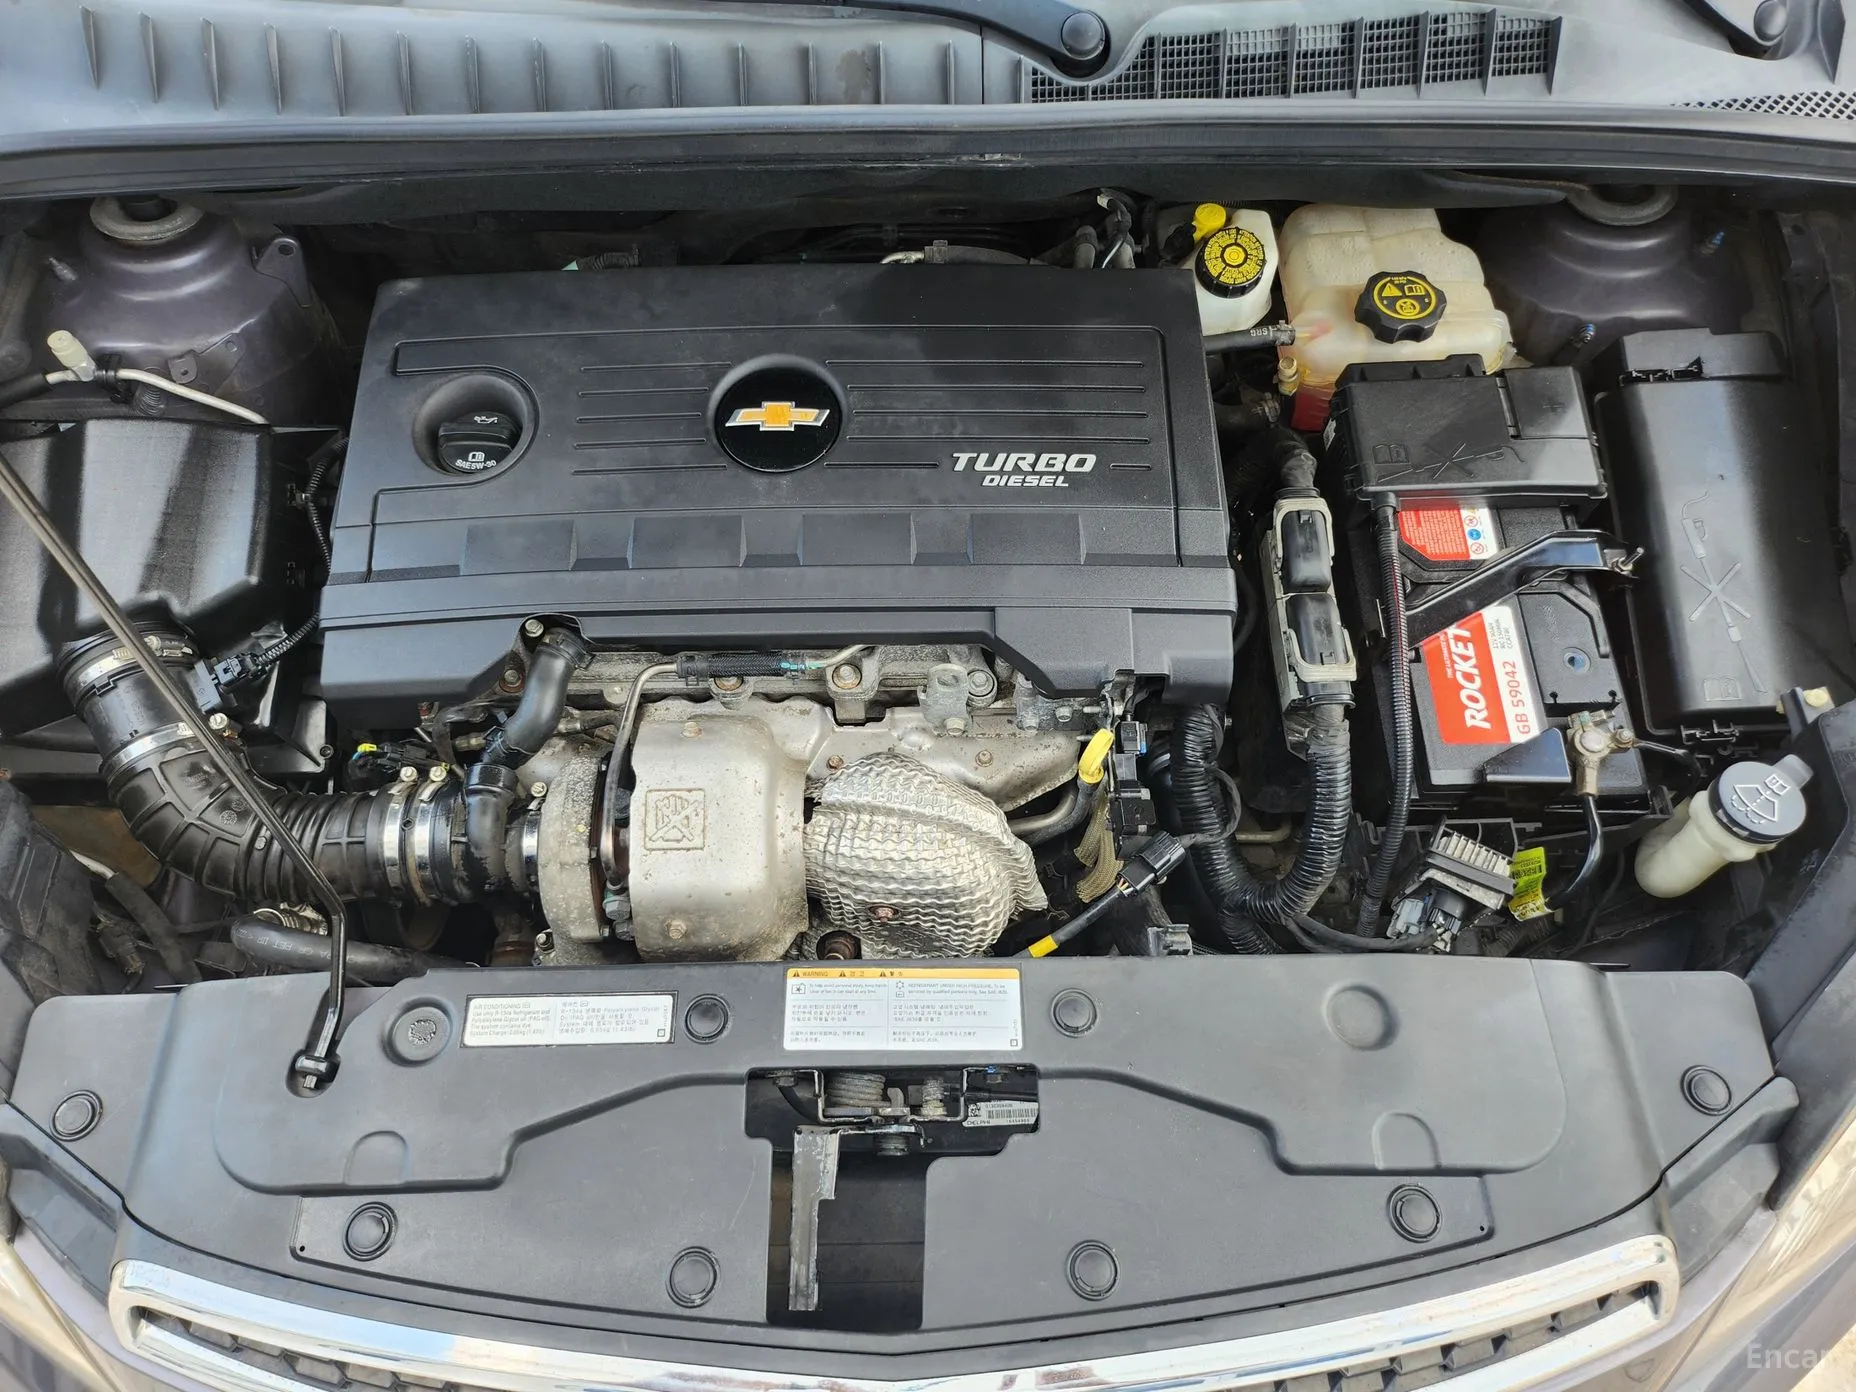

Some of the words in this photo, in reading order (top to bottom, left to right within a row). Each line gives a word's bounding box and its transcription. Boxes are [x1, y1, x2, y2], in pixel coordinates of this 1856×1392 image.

[952, 452, 1097, 473] TURBO
[982, 475, 1069, 487] DIESEL
[1447, 623, 1492, 729] ROCKET
[1502, 660, 1526, 708] 59042
[1515, 713, 1531, 734] GB
